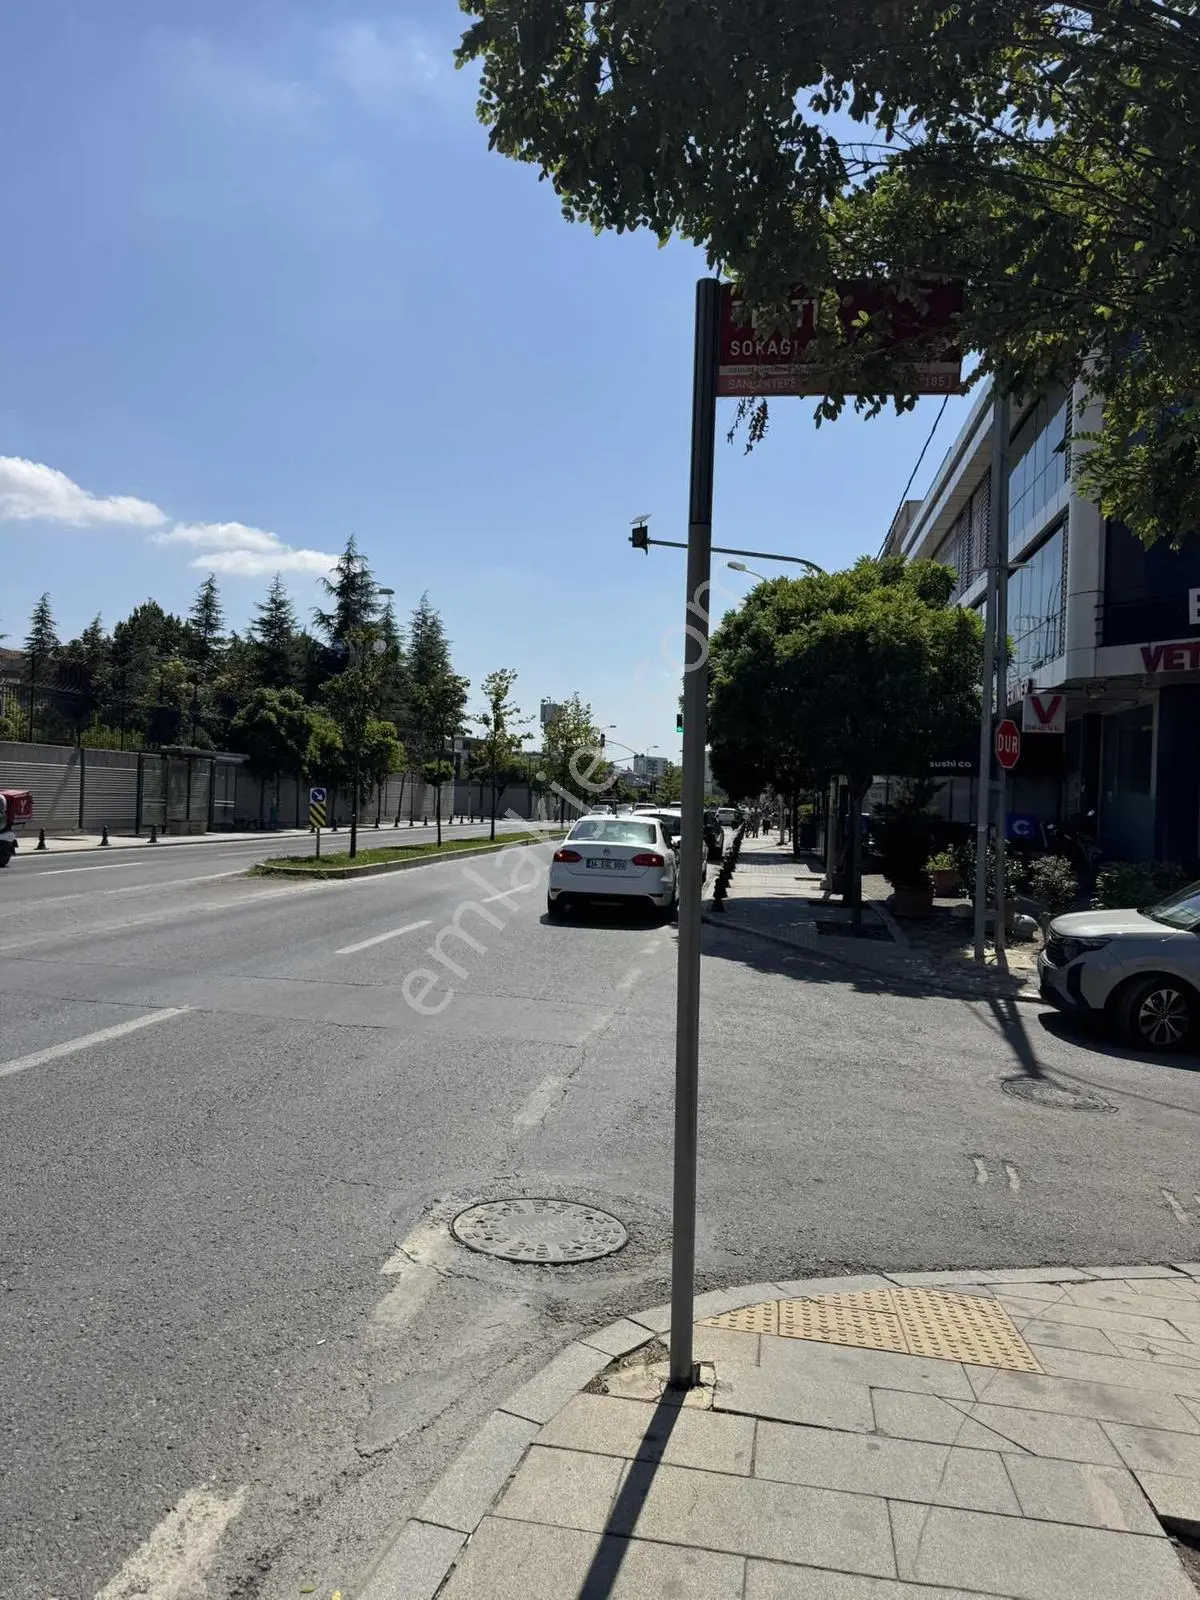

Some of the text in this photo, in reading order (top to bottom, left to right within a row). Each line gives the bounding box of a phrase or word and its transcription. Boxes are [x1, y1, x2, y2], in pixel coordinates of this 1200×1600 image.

[998, 734, 1018, 754] DUR
[929, 759, 973, 768] sushi co
